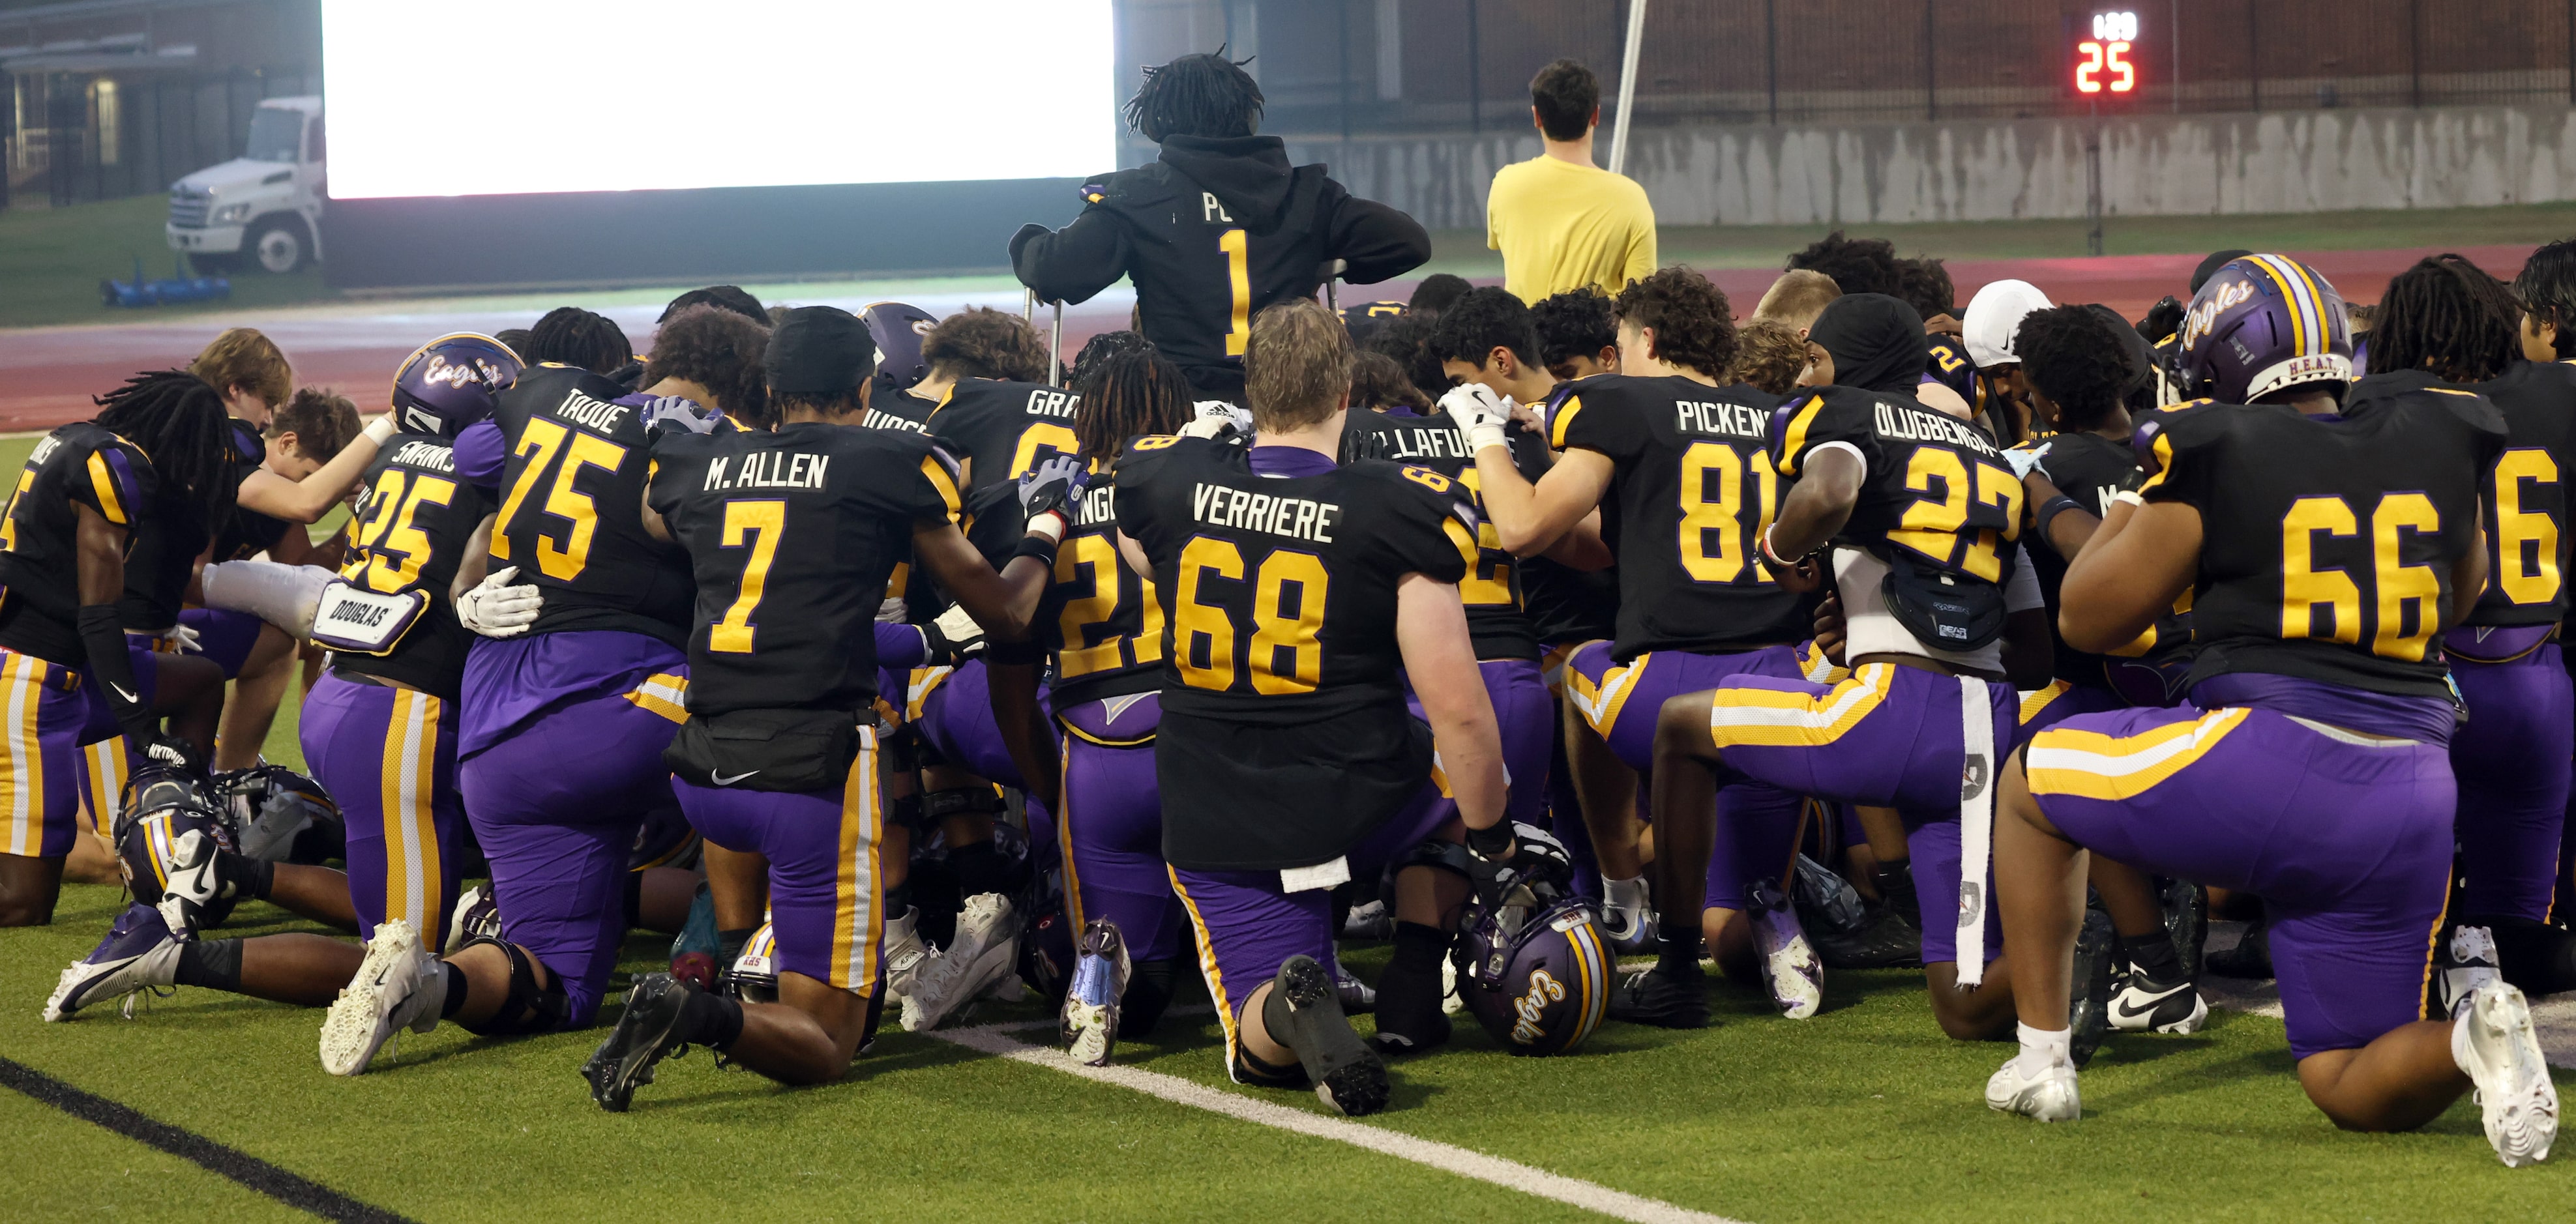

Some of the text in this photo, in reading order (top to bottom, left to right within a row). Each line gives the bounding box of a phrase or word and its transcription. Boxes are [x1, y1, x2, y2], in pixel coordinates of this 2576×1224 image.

[2077, 42, 2134, 93] 25
[1217, 228, 1251, 358] 1
[556, 388, 630, 435] TAQUE
[1206, 411, 1236, 419] adidas
[2288, 357, 2338, 376] H.E.A.T.
[340, 467, 460, 596] 25
[488, 415, 630, 582] 75
[704, 453, 829, 490] M. ALLEN
[1193, 482, 1339, 544] VERRIERE
[1676, 439, 1777, 584] 81
[1886, 444, 2024, 585] 27
[2478, 446, 2564, 605] 6
[329, 599, 389, 628] DOUGLAS
[708, 498, 788, 656] 7
[1174, 533, 1331, 696] 68
[2281, 491, 2440, 662] 66
[900, 951, 917, 967] ALPHA
